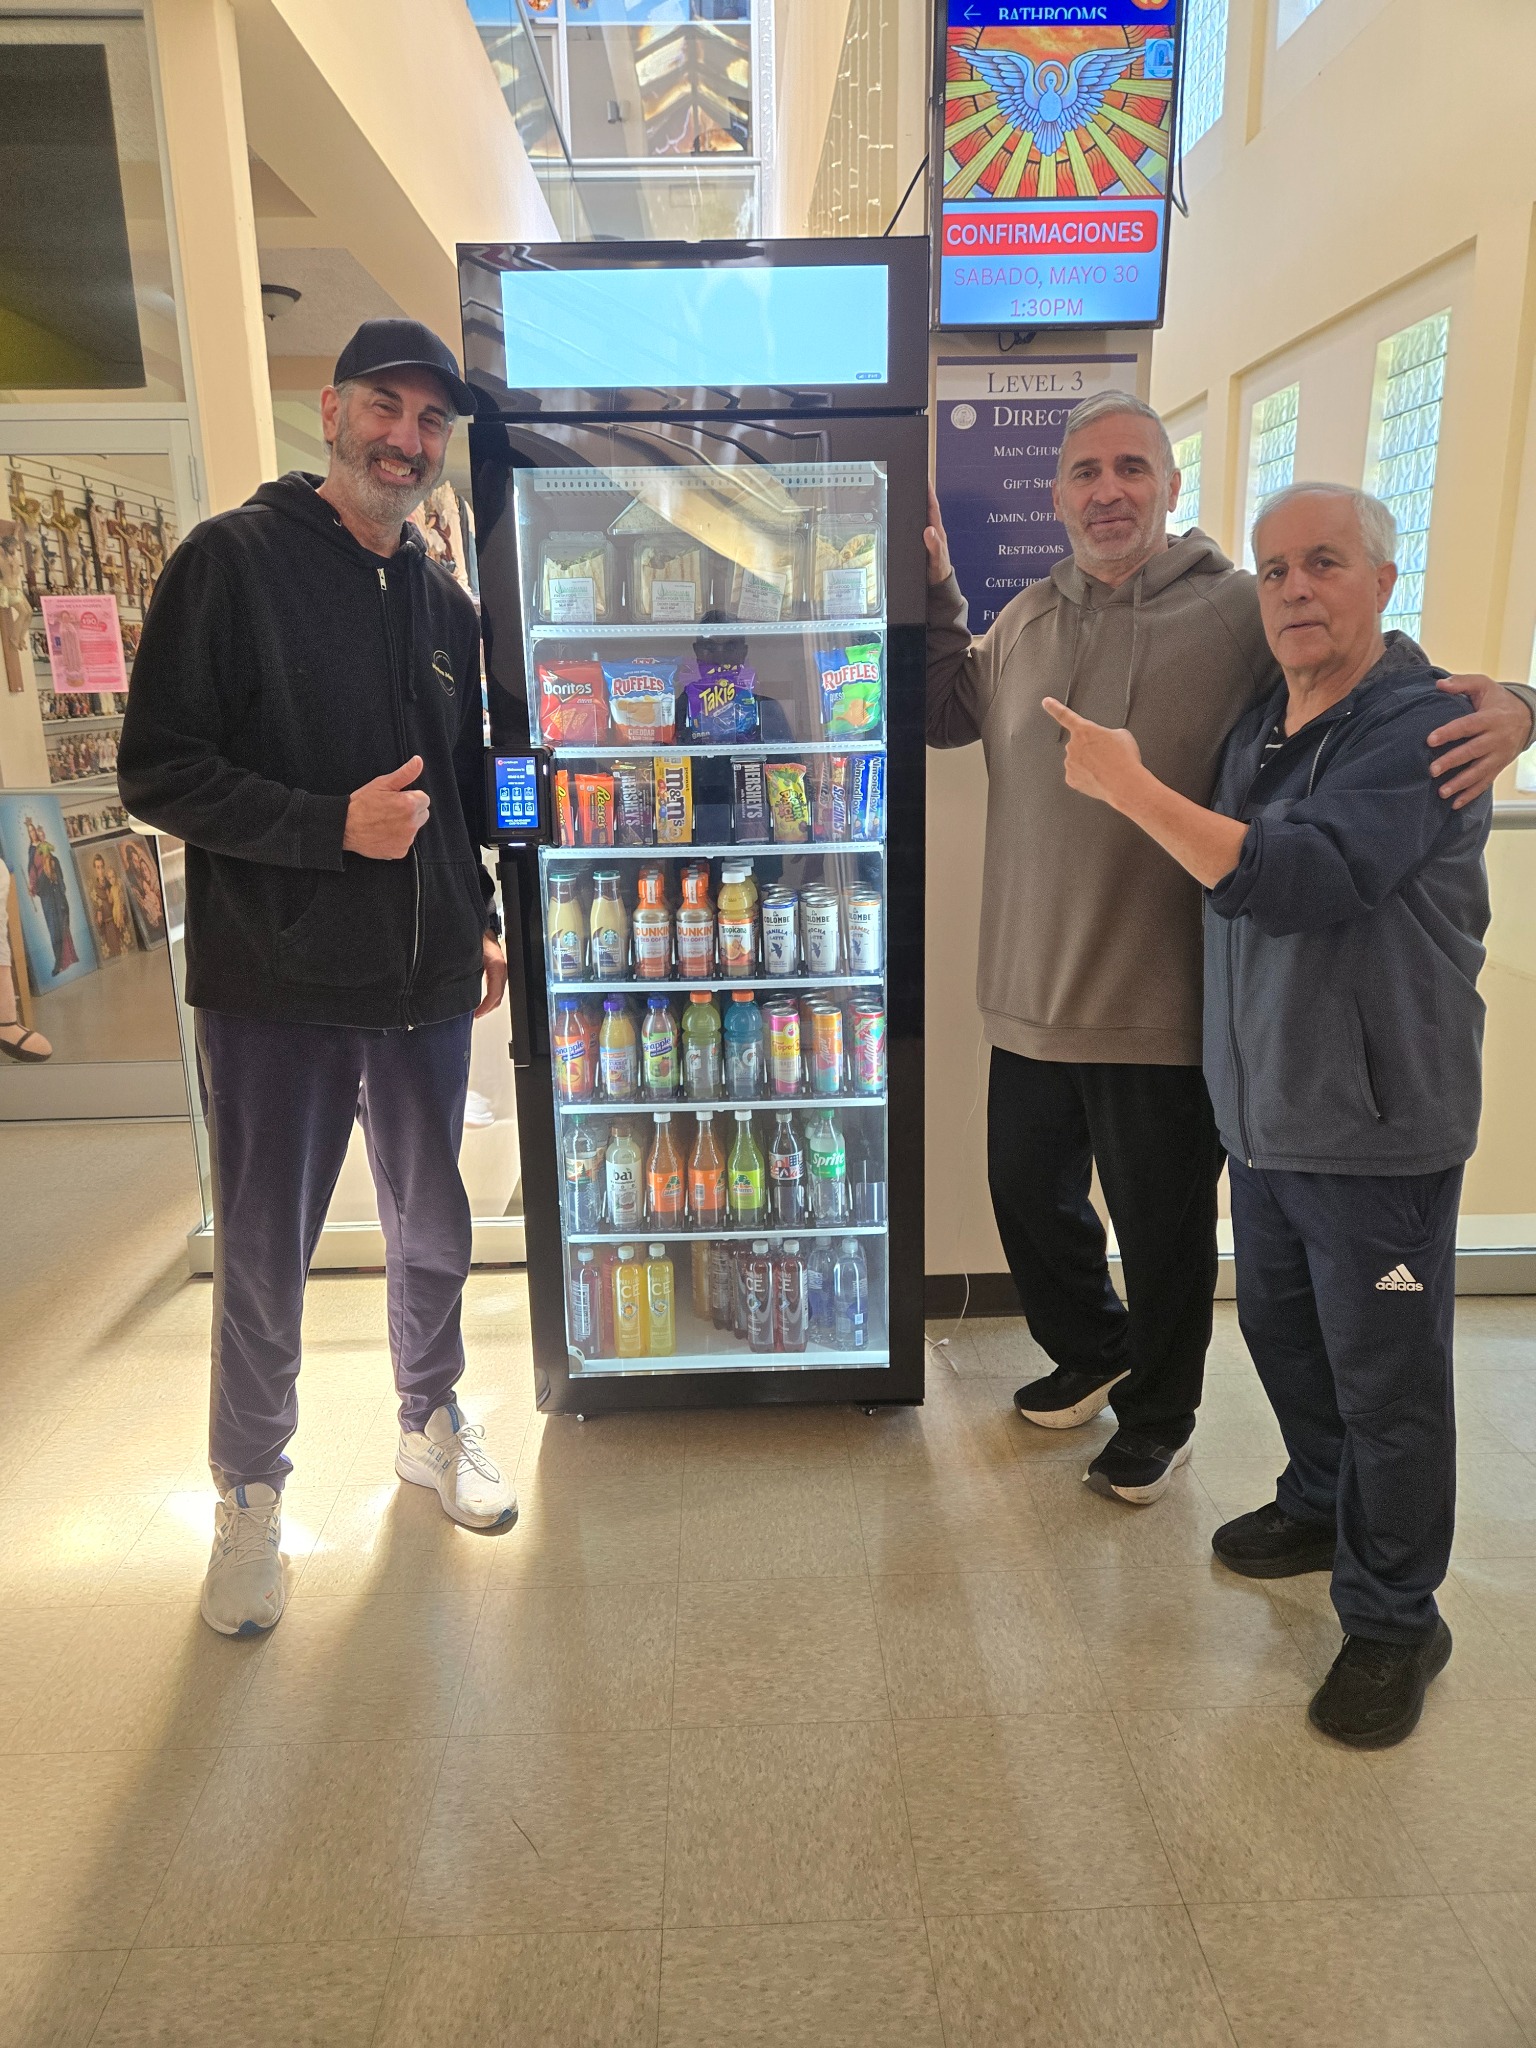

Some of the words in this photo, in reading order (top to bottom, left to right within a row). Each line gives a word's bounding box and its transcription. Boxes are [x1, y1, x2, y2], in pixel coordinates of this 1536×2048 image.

[947, 222, 1144, 245] CONFIRMACIONES
[954, 267, 1042, 289] SABADO,
[1050, 266, 1107, 284] MAYO
[1113, 265, 1138, 283] 30
[1010, 298, 1083, 317] 1:30PM
[987, 371, 1064, 394] LEVEL
[1070, 370, 1083, 391] 3
[994, 446, 1024, 457] MAIN
[1026, 445, 1061, 456] CHUR
[1003, 479, 1031, 490] GIFT
[986, 512, 1027, 523] ADMIN.
[998, 544, 1064, 555] RESTROOMS
[983, 610, 1001, 621] FU
[612, 675, 664, 697] RUFFLES
[823, 663, 878, 691] RUFFLES
[543, 681, 592, 696] Doritos
[699, 683, 735, 717] Takis
[628, 728, 655, 737] CHEDDAR
[853, 758, 865, 798] Almond
[870, 757, 881, 795] Almond
[744, 762, 763, 819] HERSHEY'S
[596, 785, 611, 828] Reese's
[621, 775, 641, 827] HERSHEY'S
[780, 790, 794, 822] PATCH
[721, 926, 747, 934] Tropicana
[766, 928, 788, 936] VANILLA
[812, 1152, 845, 1168] Sprite
[1375, 1282, 1424, 1291] adidas
